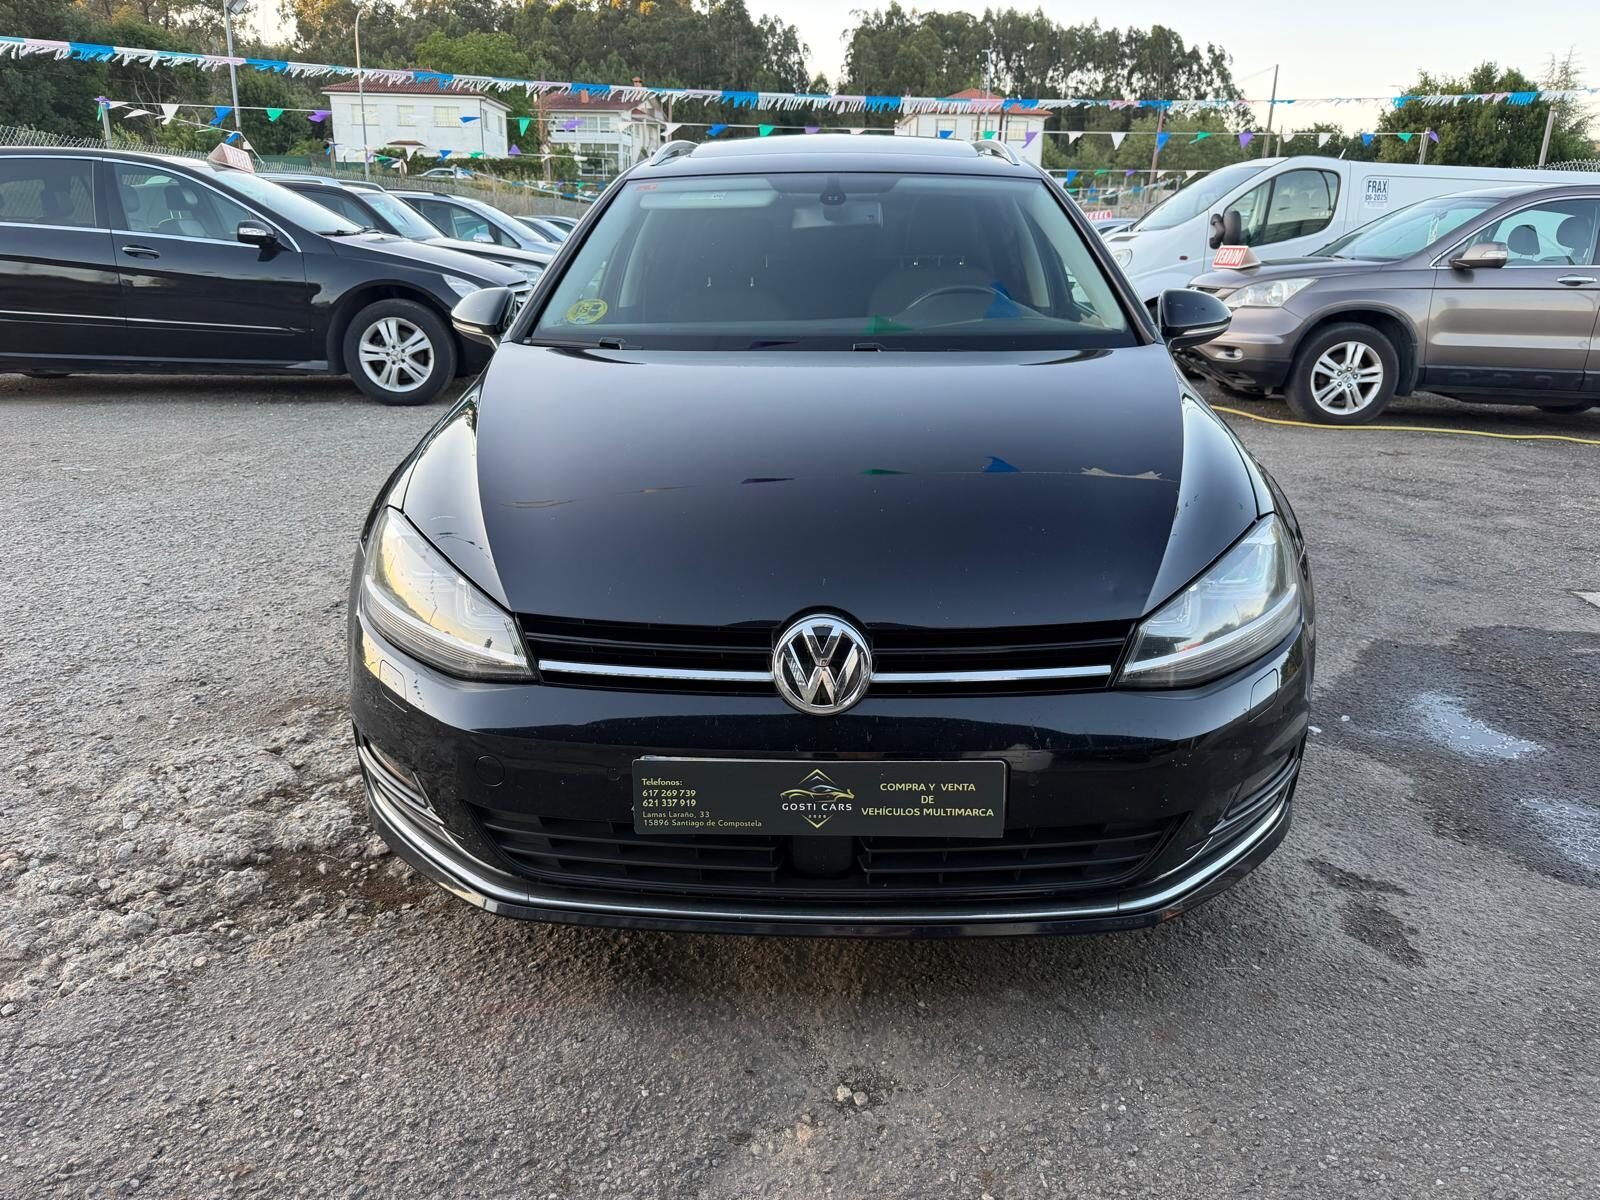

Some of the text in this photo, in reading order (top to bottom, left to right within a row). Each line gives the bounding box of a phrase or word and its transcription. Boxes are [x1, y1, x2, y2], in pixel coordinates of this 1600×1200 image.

[1367, 180, 1388, 193] FRAX
[641, 778, 683, 786] Telefonos:
[880, 783, 976, 792] COMPRA Y VENTA
[642, 789, 696, 797] 617 269 739
[642, 799, 696, 807] 621 337 919
[921, 796, 935, 804] DE
[782, 803, 853, 811] GOSTI CARS
[668, 811, 697, 819] Laraño,
[861, 806, 994, 817] VEHÍCULOS MULTIMARCA
[671, 819, 705, 828] Santiago
[706, 819, 716, 827] de
[718, 820, 762, 829] Compostela
